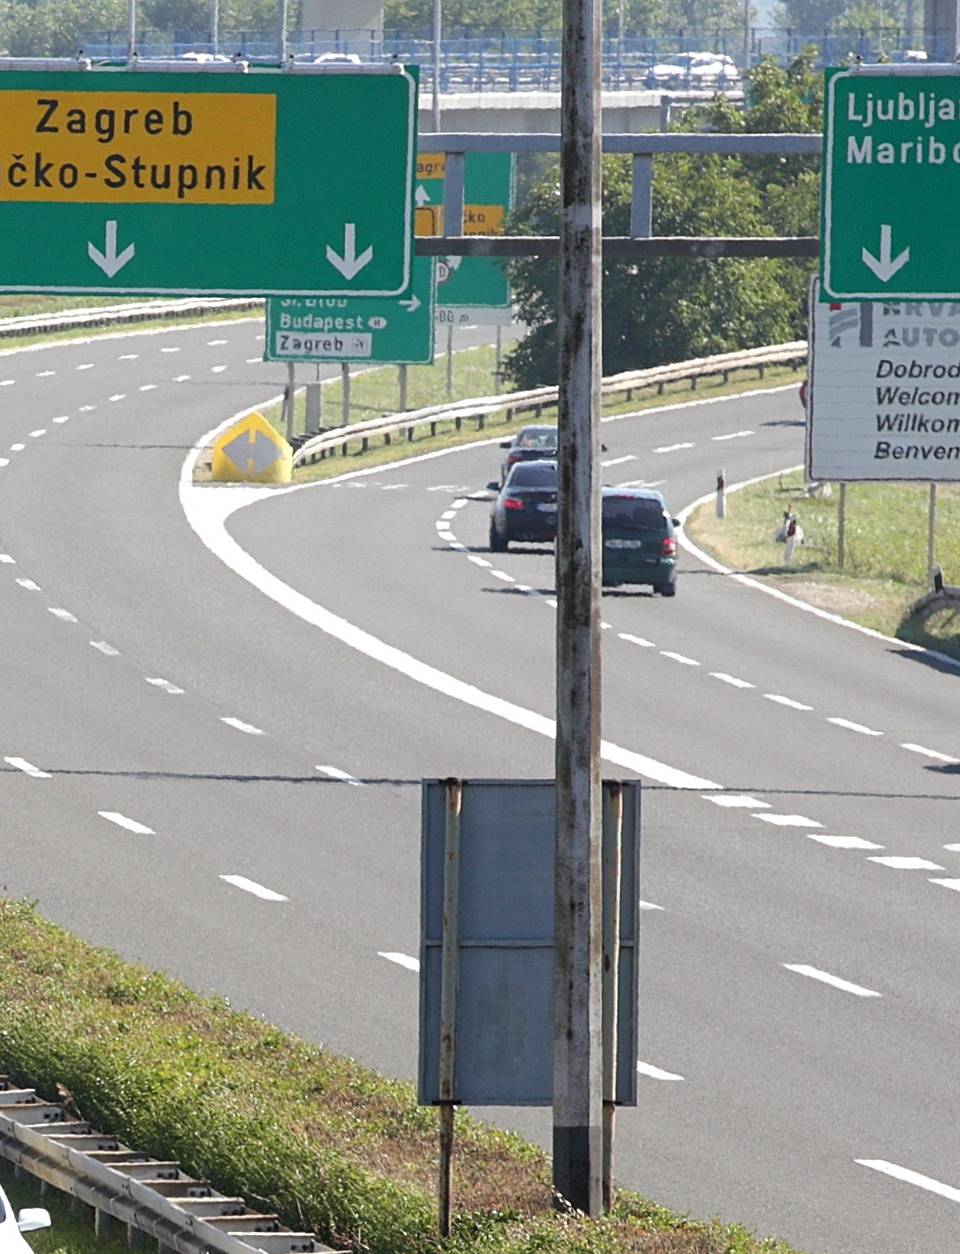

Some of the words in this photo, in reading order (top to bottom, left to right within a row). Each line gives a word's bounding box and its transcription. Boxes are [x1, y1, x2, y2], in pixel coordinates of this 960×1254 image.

[35, 98, 194, 144] Zagreb
[847, 91, 960, 128] Ljublja
[280, 313, 363, 332] Budapest
[280, 335, 344, 353] Zagreb
